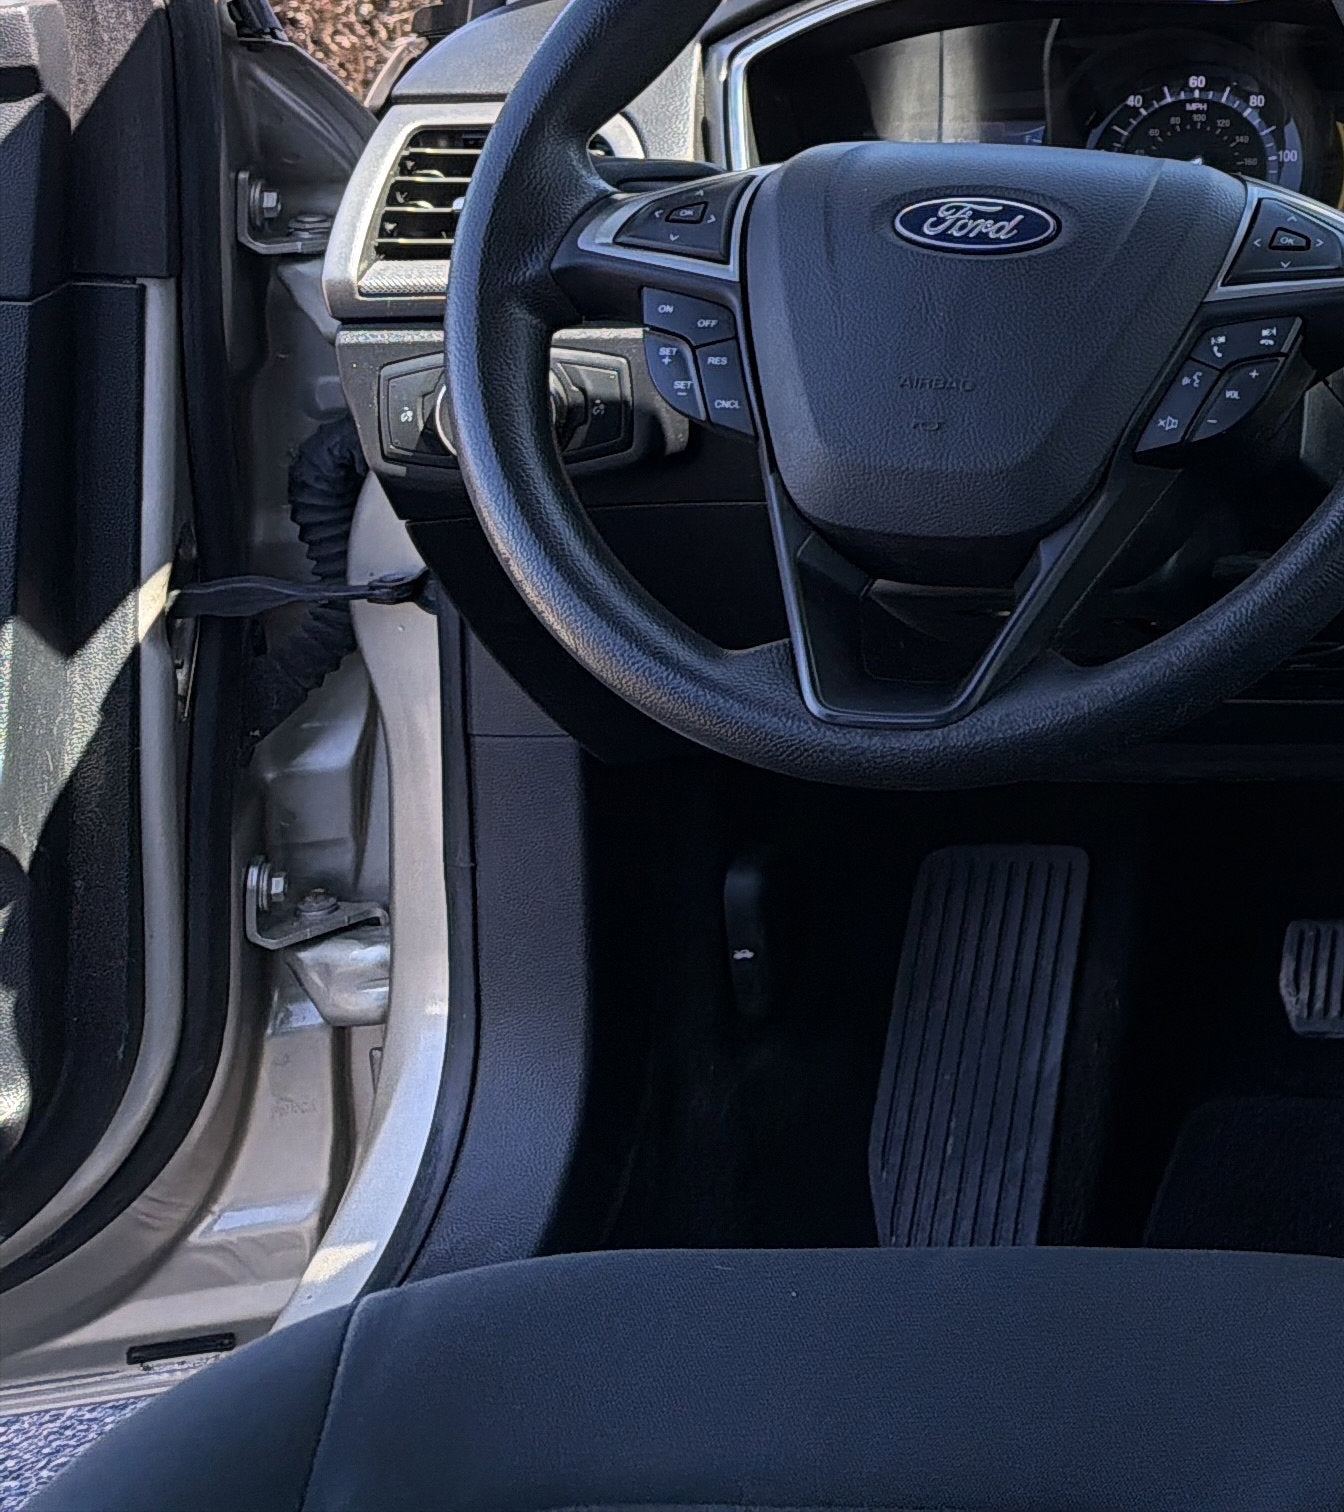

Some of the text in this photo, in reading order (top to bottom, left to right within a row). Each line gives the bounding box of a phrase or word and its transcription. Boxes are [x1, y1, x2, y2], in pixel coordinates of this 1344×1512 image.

[1188, 75, 1206, 88] 60
[1127, 95, 1143, 107] 40
[1250, 95, 1265, 107] 80
[1186, 103, 1207, 111] MPH
[1278, 150, 1298, 162] 100
[923, 202, 1024, 239] Ford
[1280, 237, 1295, 245] OK
[658, 304, 674, 314] ON
[697, 319, 718, 328] OFF
[659, 347, 678, 356] SET
[707, 356, 728, 366] RES
[674, 380, 692, 389] SET
[1225, 390, 1240, 400] VOL
[715, 399, 741, 409] CNCL
